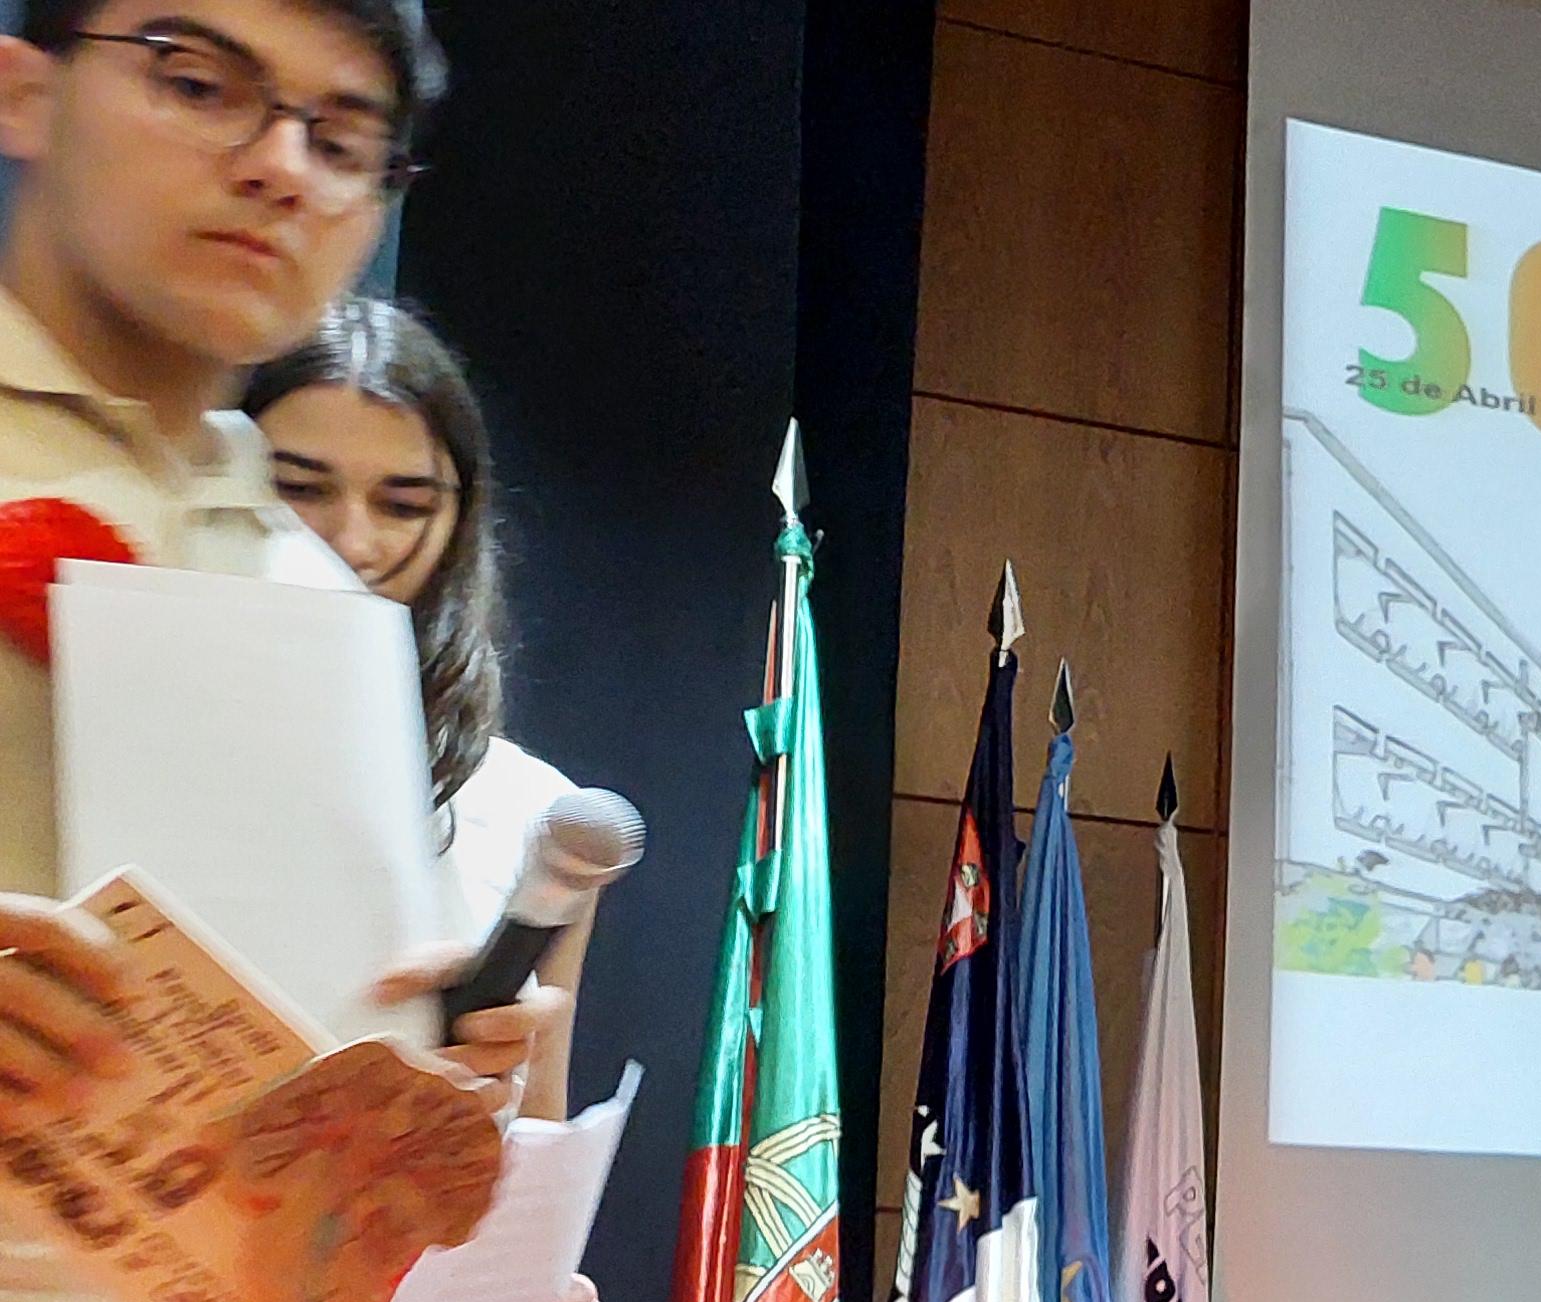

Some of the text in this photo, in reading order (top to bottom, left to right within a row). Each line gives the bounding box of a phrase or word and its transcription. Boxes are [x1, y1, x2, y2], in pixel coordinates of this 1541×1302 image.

[1345, 364, 1537, 417] 25 de Abril
